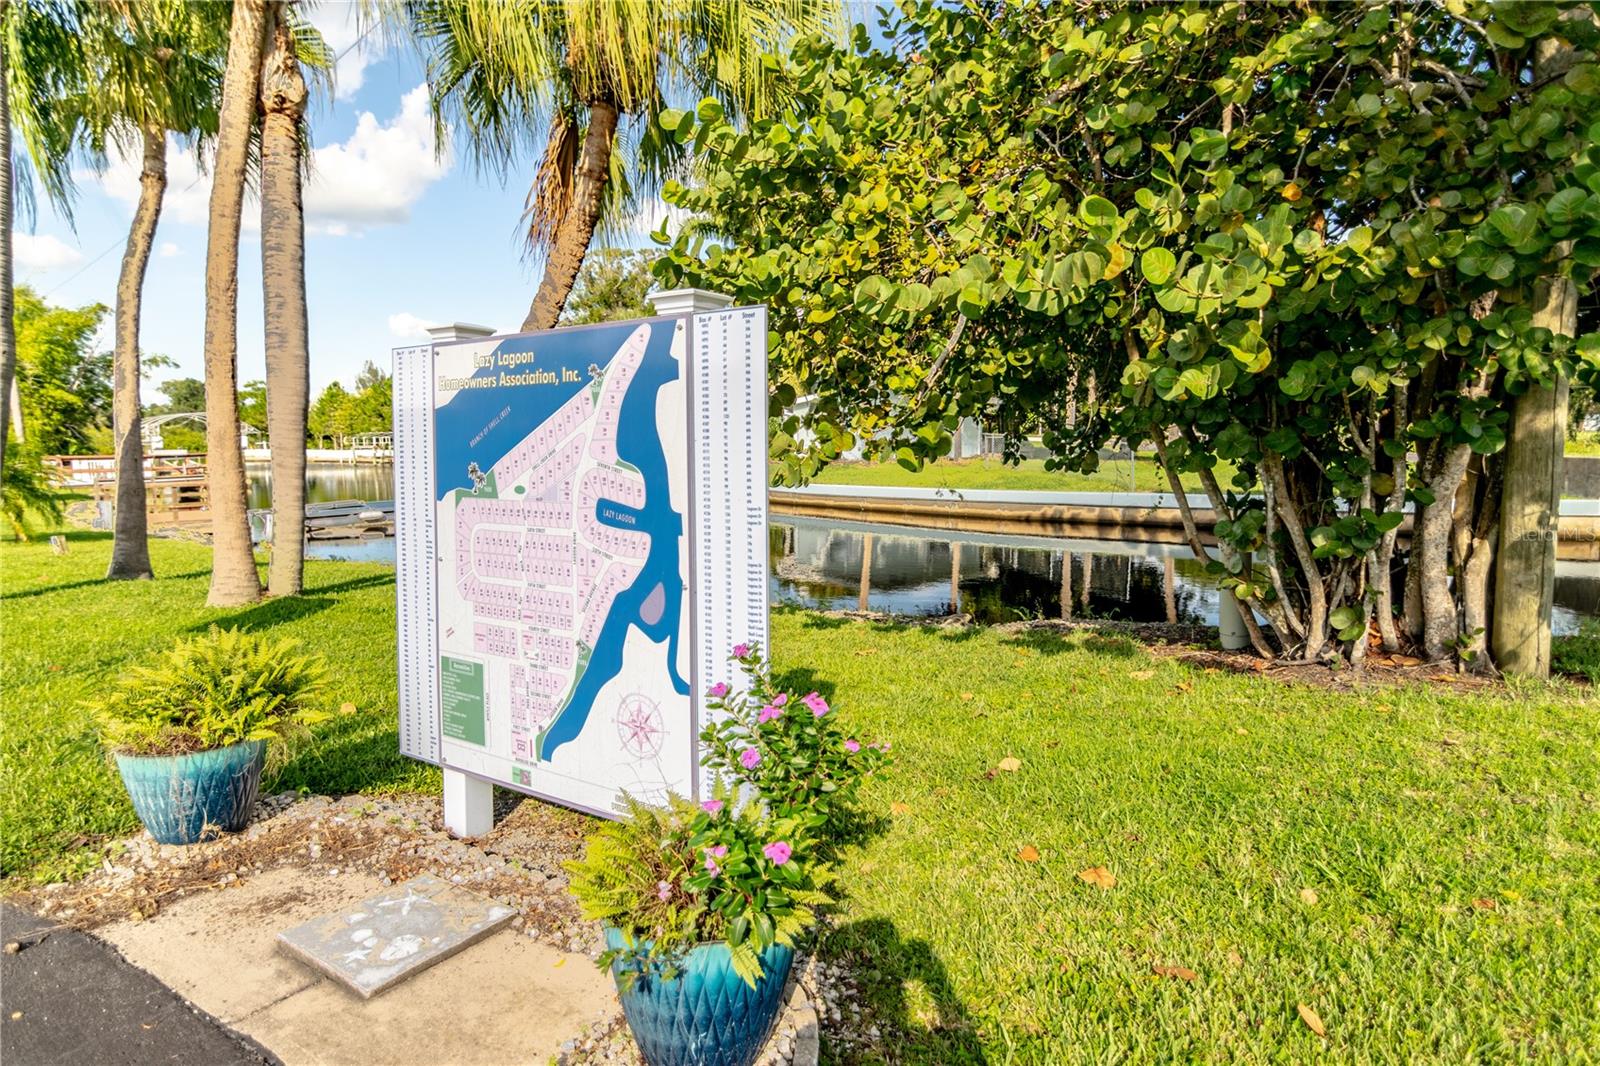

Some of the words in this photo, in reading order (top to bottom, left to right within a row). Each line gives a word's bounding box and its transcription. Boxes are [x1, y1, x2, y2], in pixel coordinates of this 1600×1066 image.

[473, 352, 495, 369] Lazy
[497, 350, 534, 367] Lagoon
[438, 374, 497, 391] Homeowners
[499, 369, 560, 387] Association,
[562, 367, 582, 382] Inc.
[603, 508, 615, 519] LAZY
[615, 511, 636, 525] LAGOON
